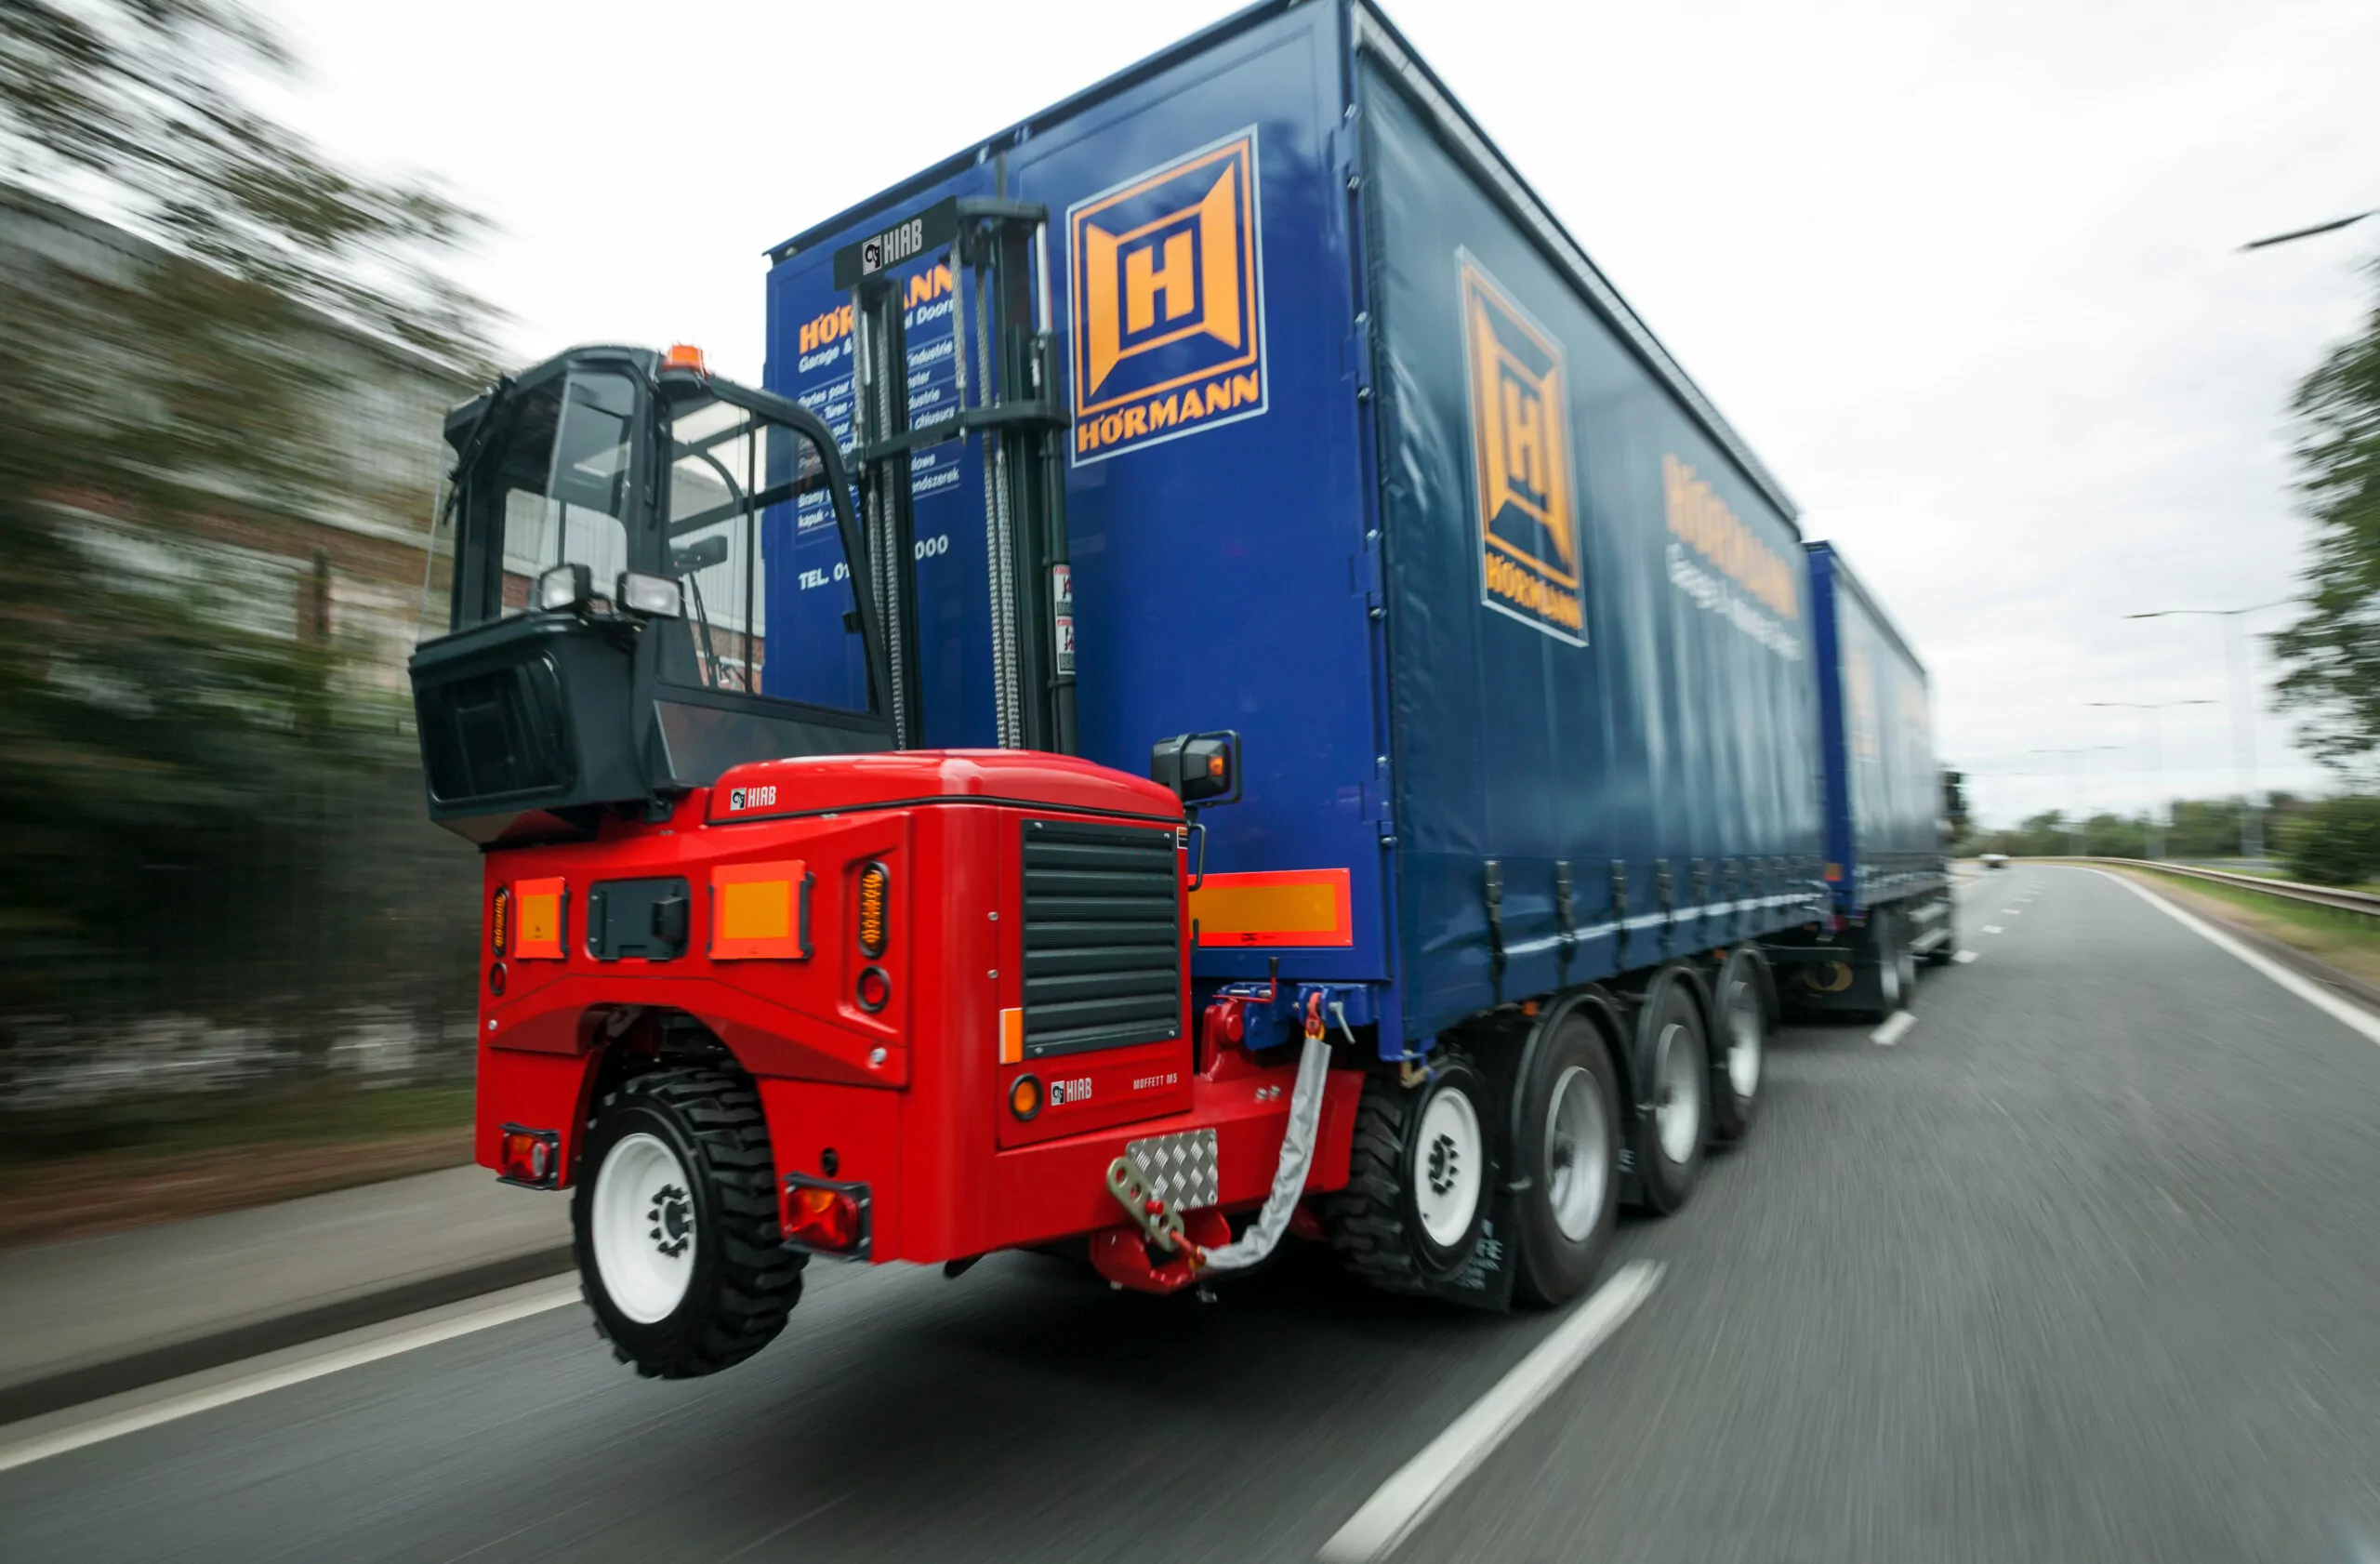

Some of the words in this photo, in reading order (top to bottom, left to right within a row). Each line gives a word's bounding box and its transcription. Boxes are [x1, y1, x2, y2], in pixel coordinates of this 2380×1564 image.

[883, 219, 922, 264] HIAB
[1126, 228, 1195, 336] H
[799, 346, 840, 374] Garage
[1078, 368, 1260, 453] HÖRMANN
[799, 568, 829, 590] TEL.
[915, 534, 948, 560] 000
[747, 786, 776, 808] HIAB
[1066, 1078, 1092, 1102] HIAB
[1133, 1075, 1164, 1090] MOFFETT
[1167, 1073, 1178, 1084] M5
